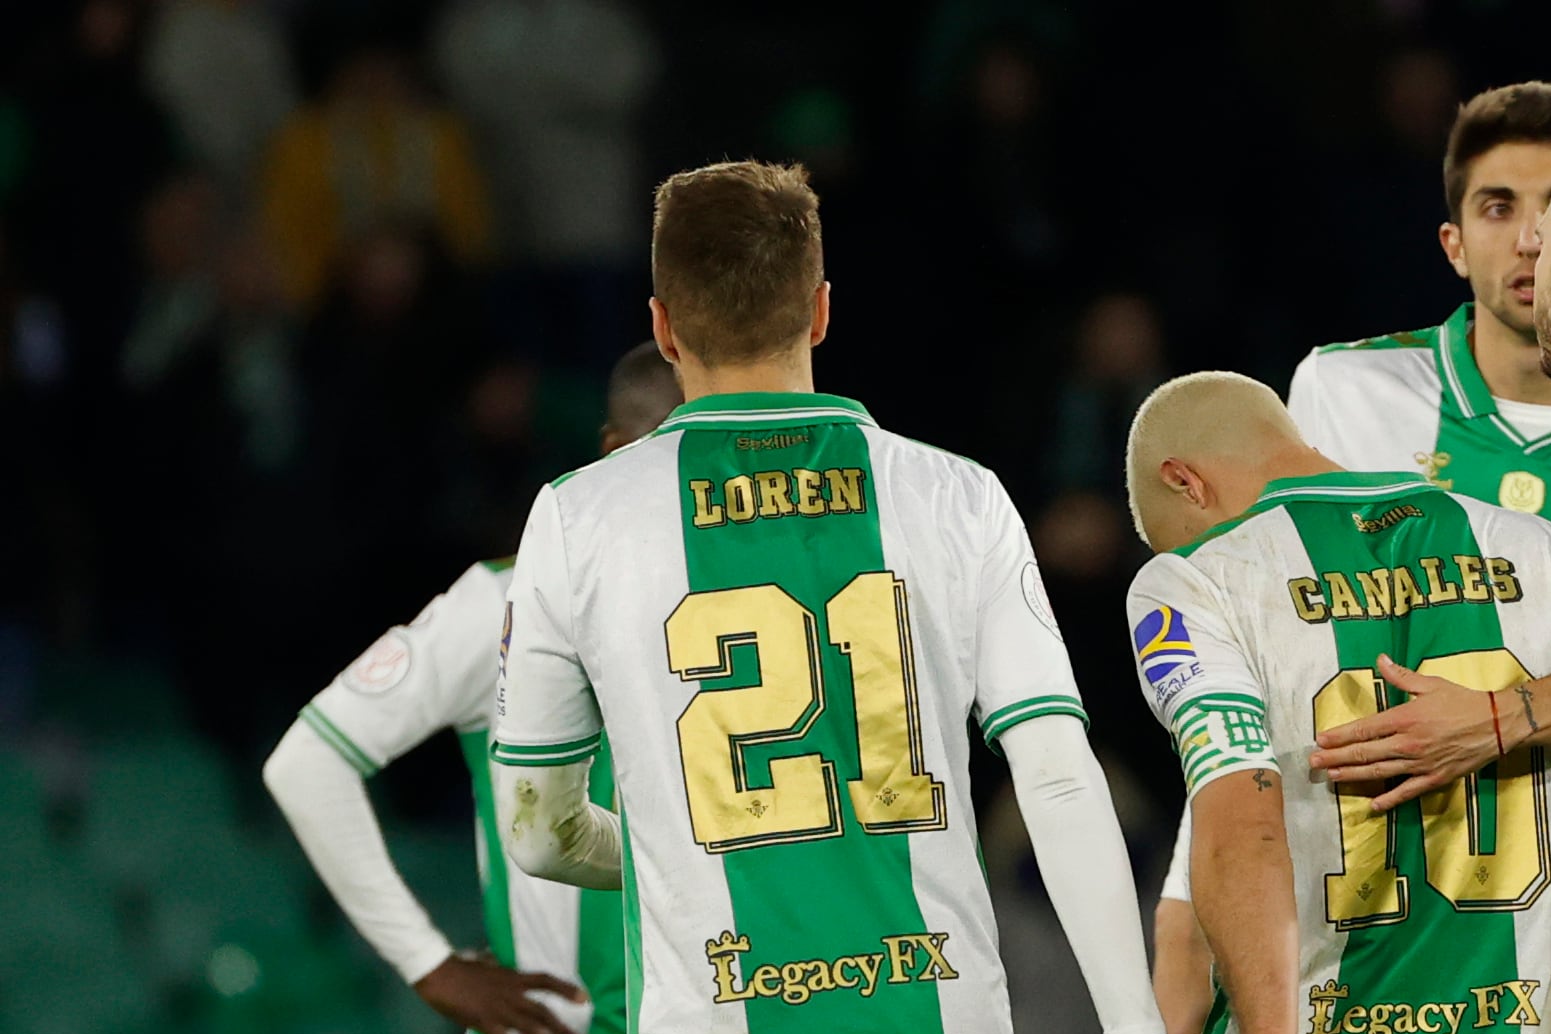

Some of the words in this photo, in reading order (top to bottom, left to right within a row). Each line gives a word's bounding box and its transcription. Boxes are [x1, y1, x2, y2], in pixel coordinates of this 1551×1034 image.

[689, 466, 866, 529] LOREN
[1287, 555, 1524, 624] CANALES
[664, 569, 948, 854] 21
